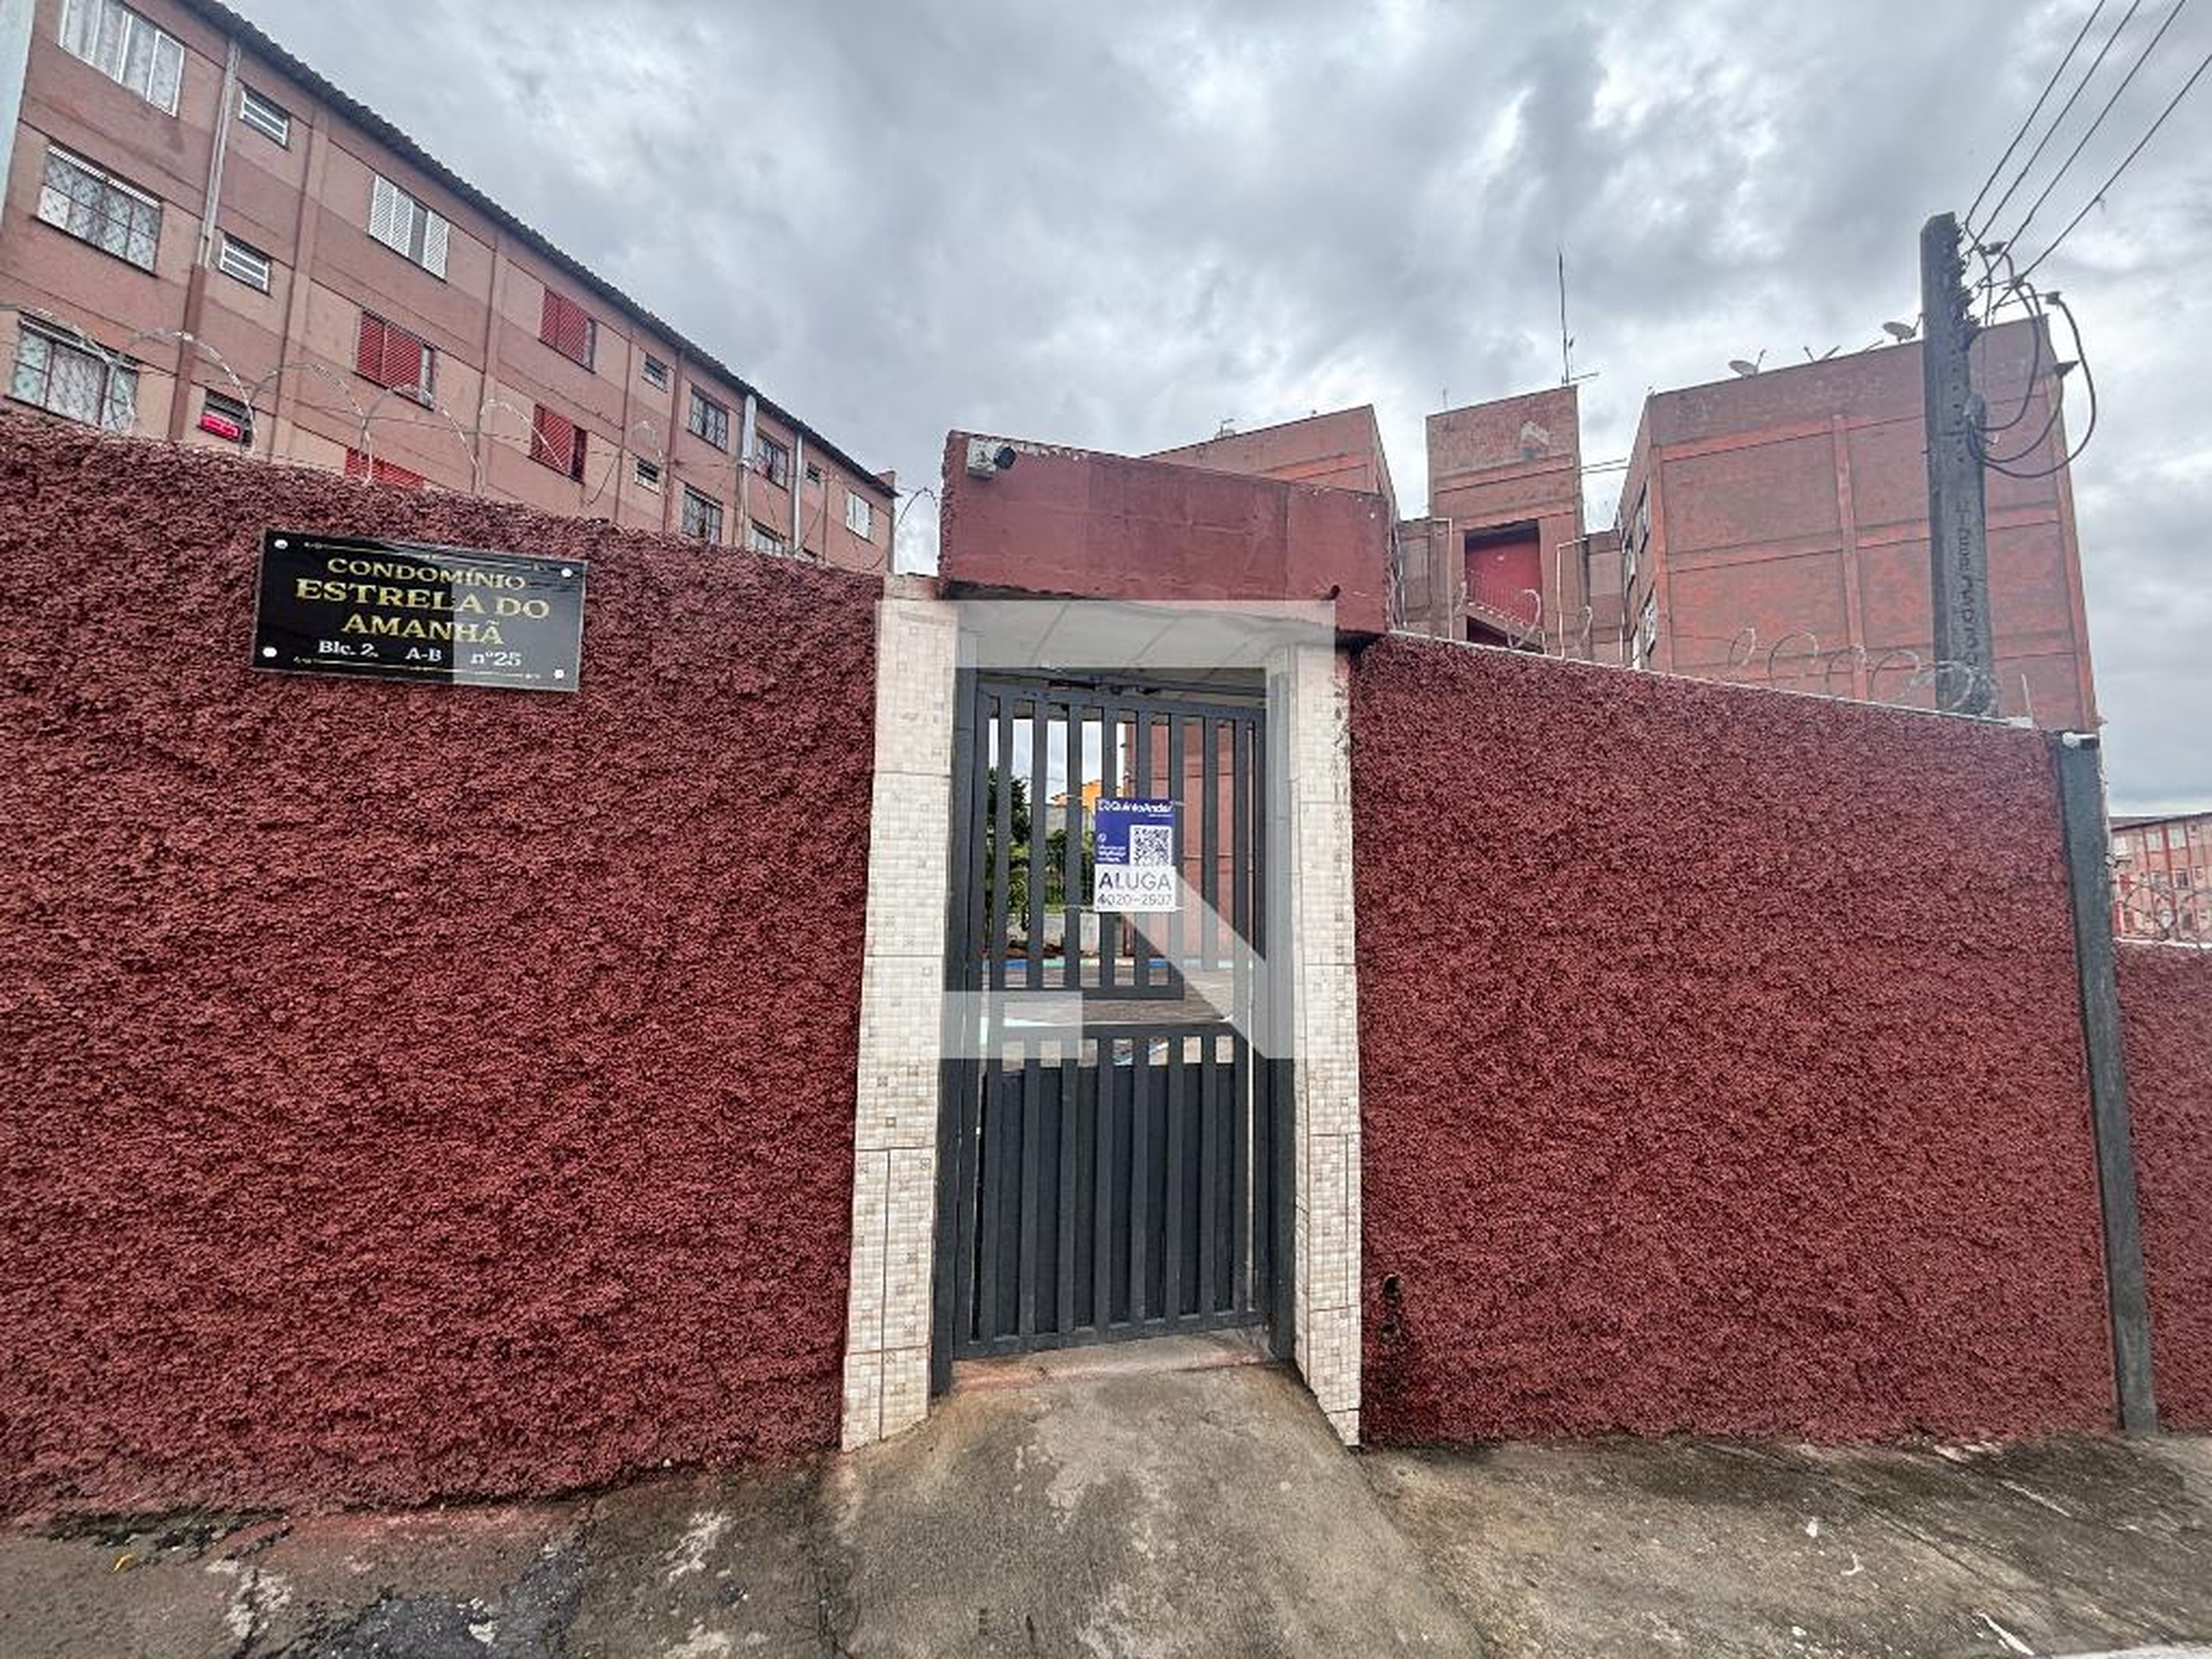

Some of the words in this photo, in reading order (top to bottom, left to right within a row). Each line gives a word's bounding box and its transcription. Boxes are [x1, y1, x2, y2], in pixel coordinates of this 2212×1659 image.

[327, 558, 525, 589] CONDOMÍNIO
[295, 578, 485, 614] ESTRELA
[496, 596, 550, 619] DO
[341, 612, 504, 644] AMANHÃ
[406, 647, 442, 662] A-B
[1099, 872, 1172, 891] ALUGA
